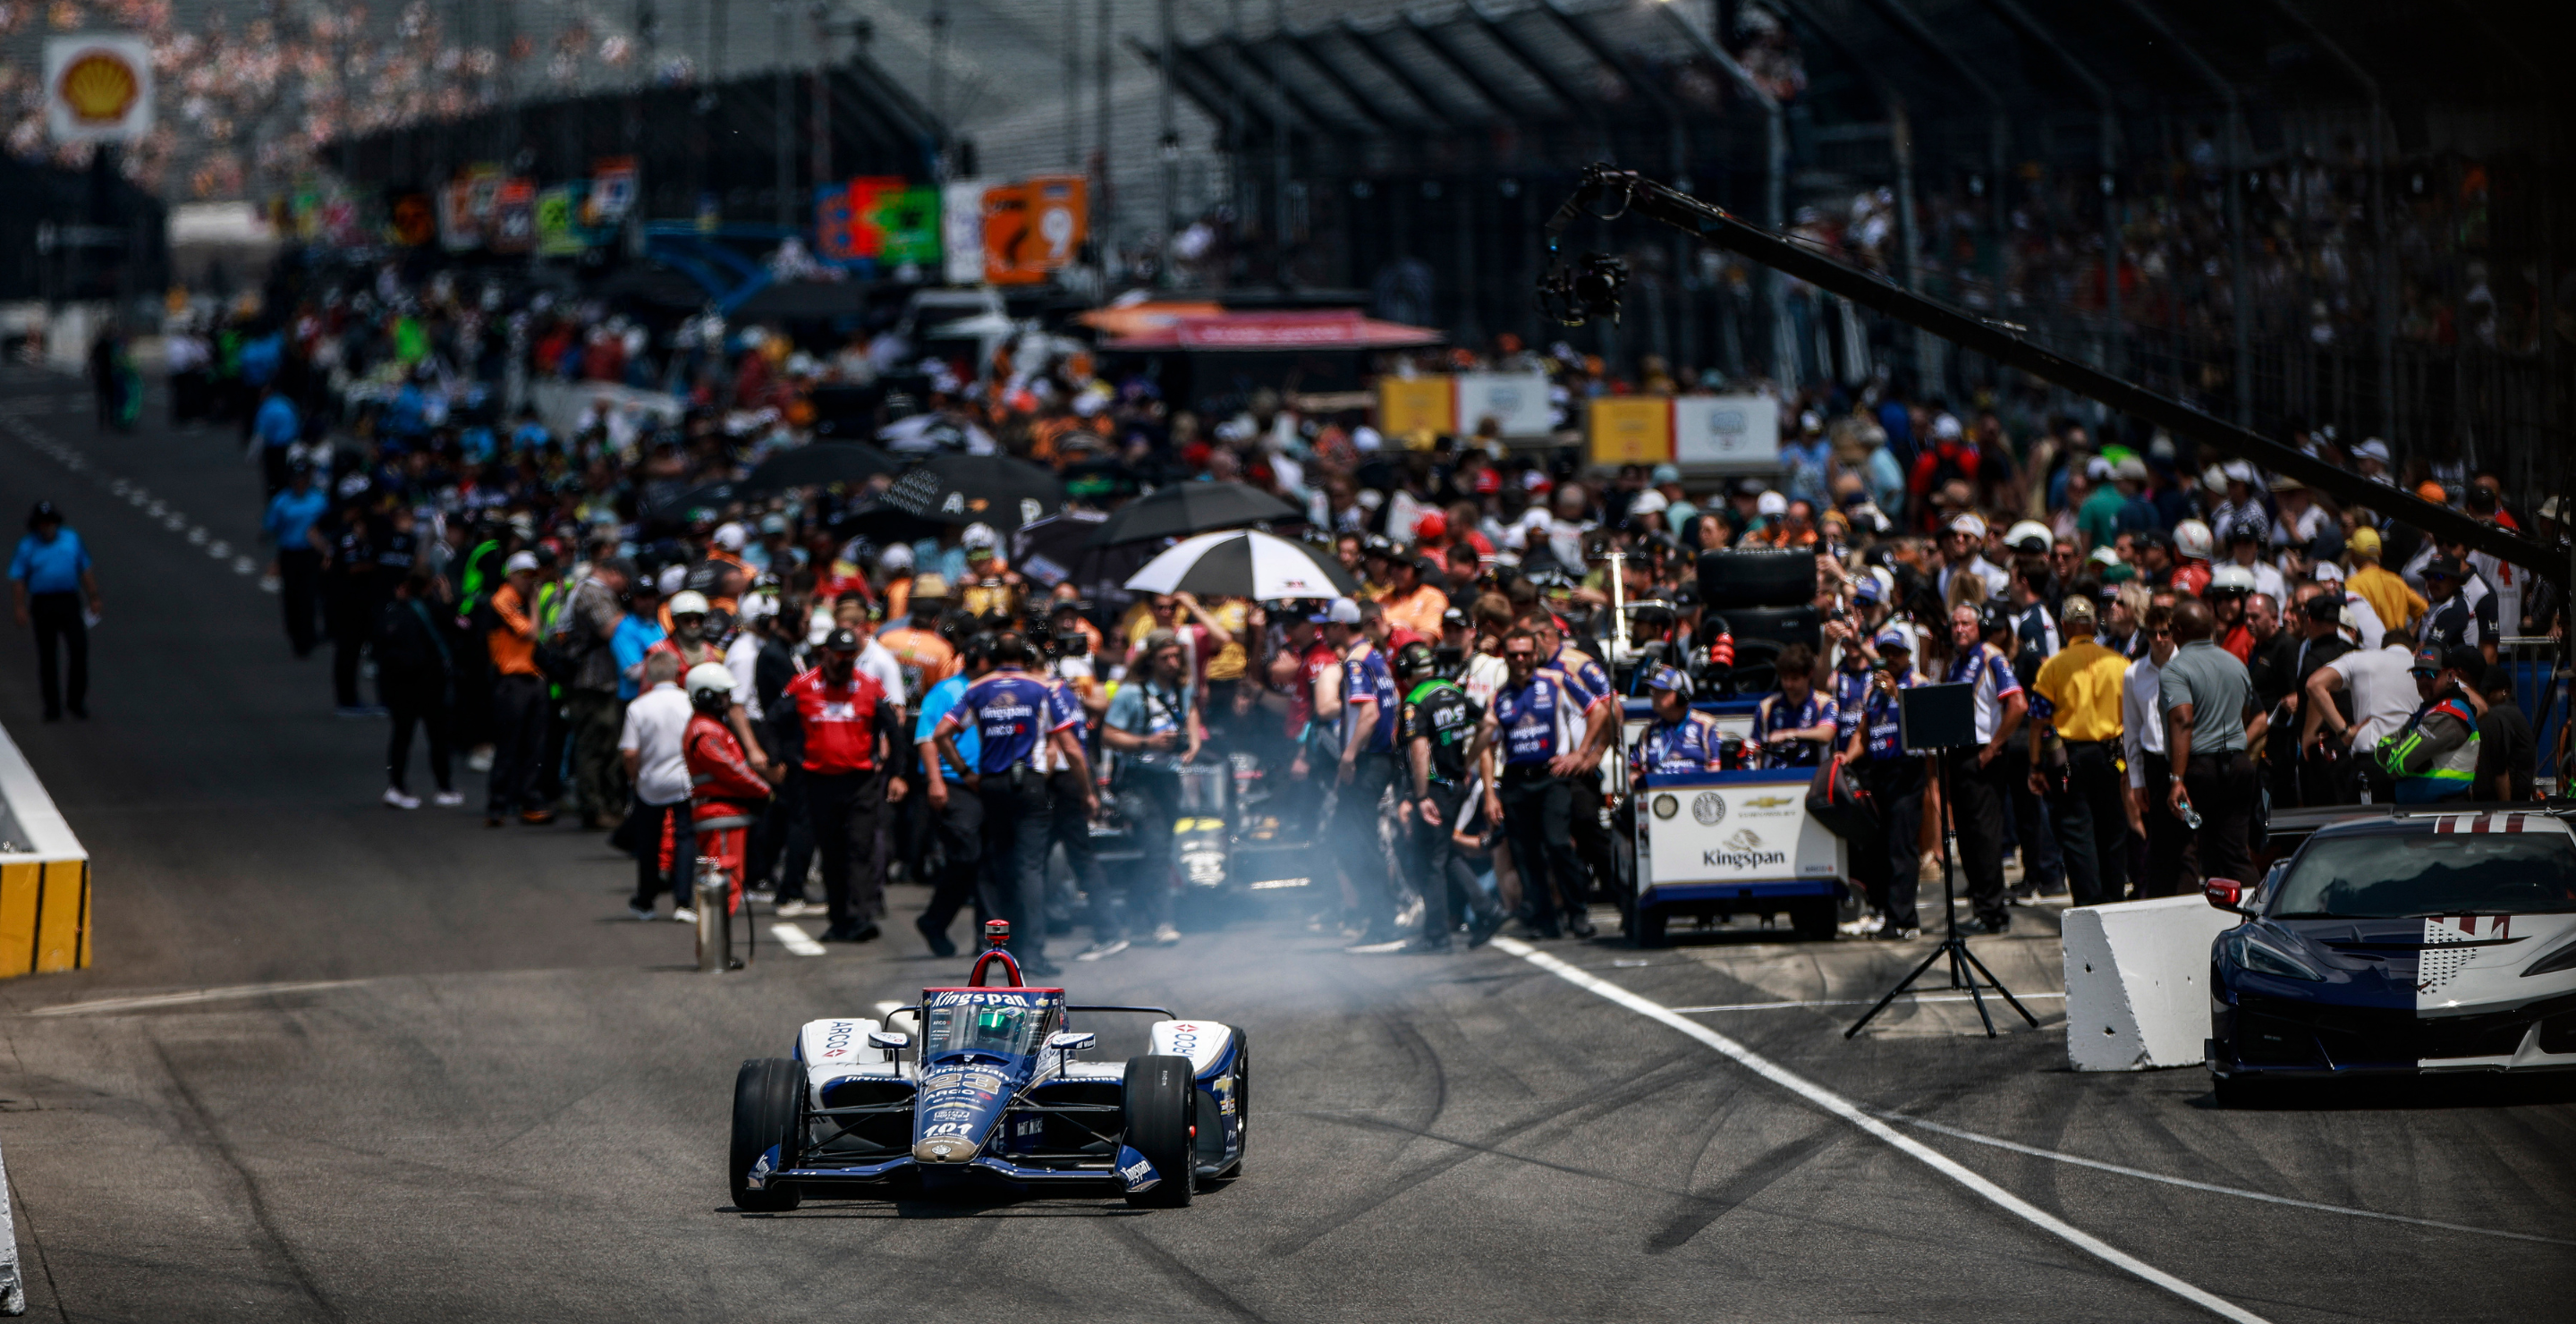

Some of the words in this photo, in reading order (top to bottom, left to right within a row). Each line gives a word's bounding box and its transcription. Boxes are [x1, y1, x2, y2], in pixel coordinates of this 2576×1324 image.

[1040, 208, 1073, 259] 9
[979, 705, 1032, 720] Kingspan
[986, 726, 1015, 737] ARCO
[1703, 849, 1785, 869] Kingspan
[932, 991, 1029, 1007] Kingspan
[826, 1022, 853, 1048] ARCO
[1173, 1033, 1197, 1062] RCO
[924, 1073, 1002, 1097] 23
[925, 1089, 975, 1102] ARCO
[923, 1122, 973, 1137] 101
